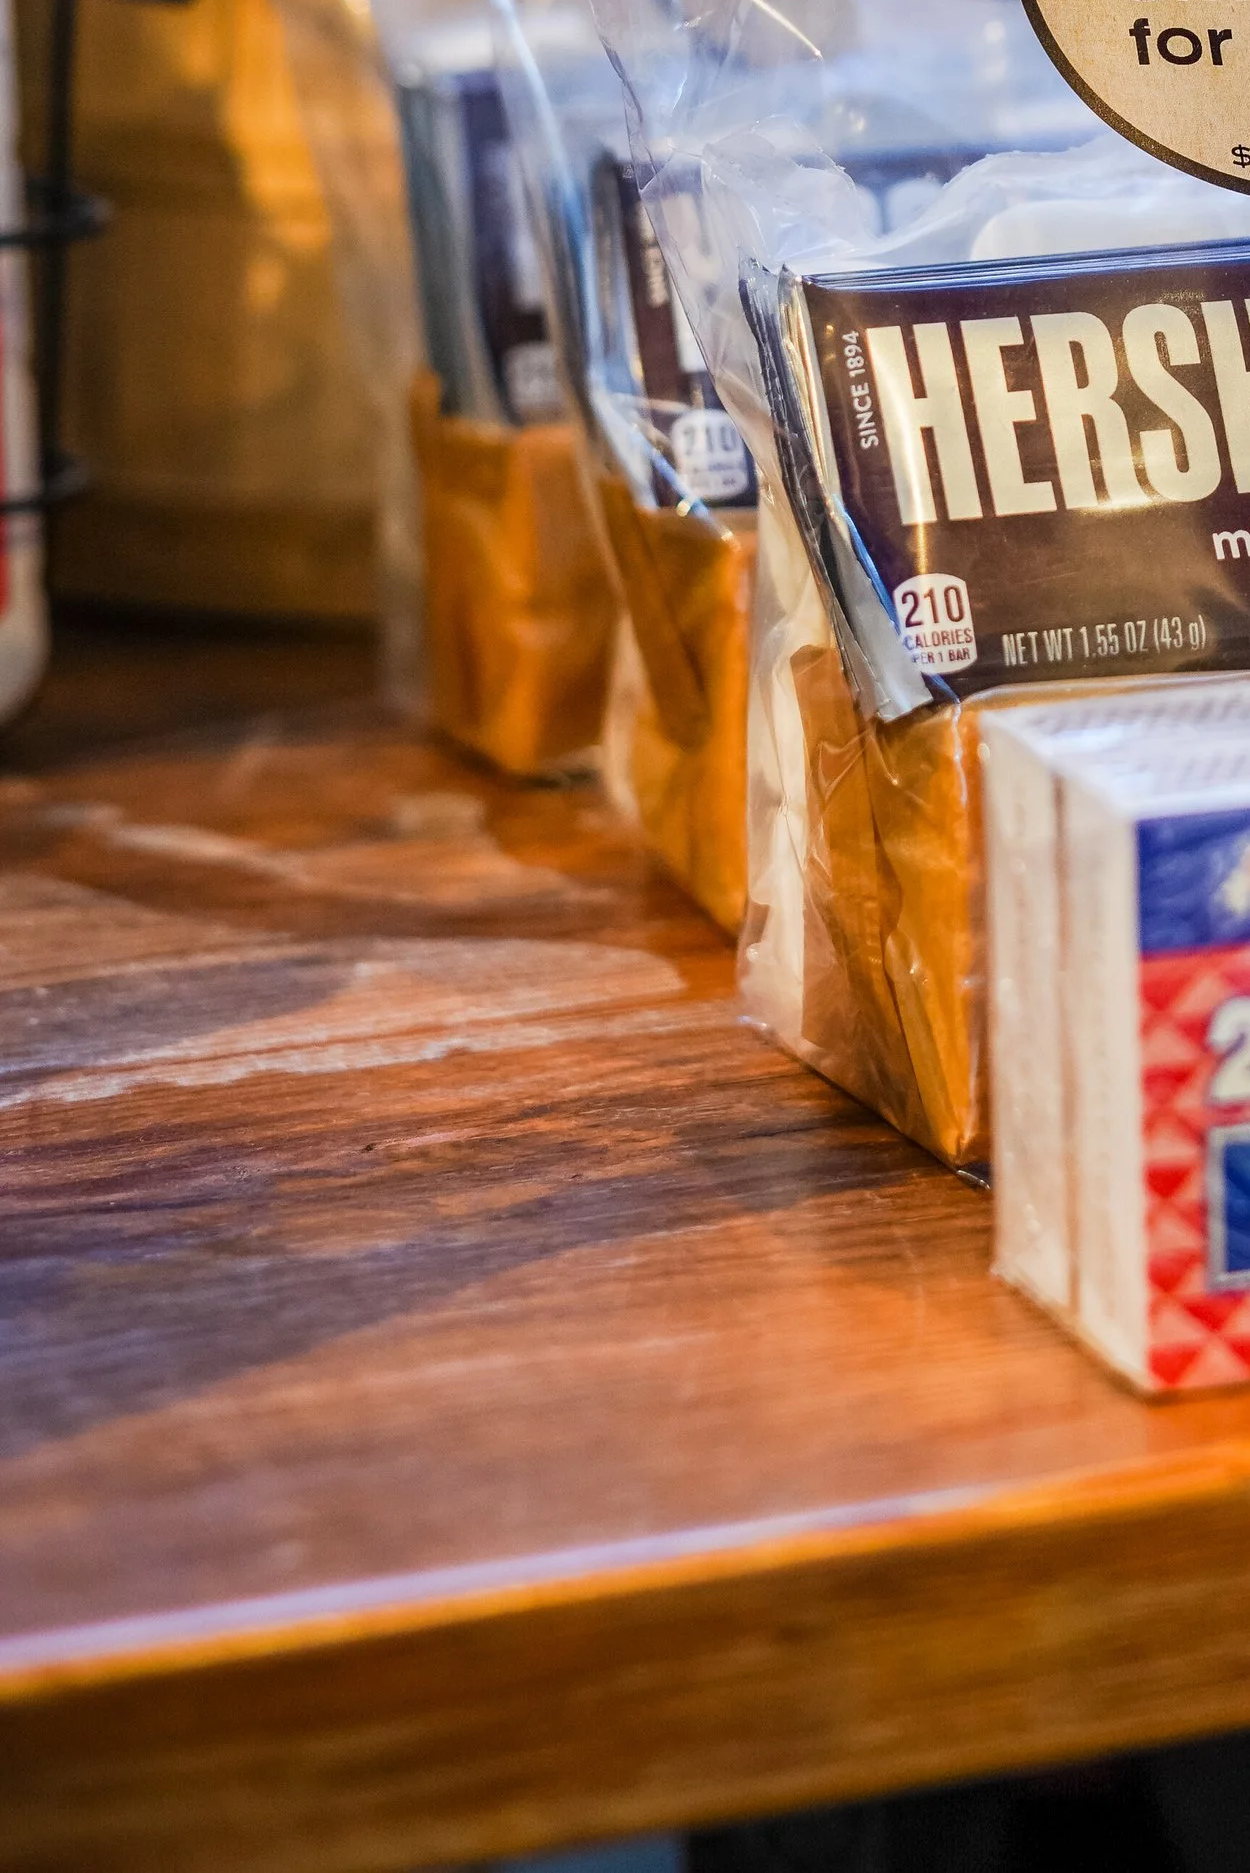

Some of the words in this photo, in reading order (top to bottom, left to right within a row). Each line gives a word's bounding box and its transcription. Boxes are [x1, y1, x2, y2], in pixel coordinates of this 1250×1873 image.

[1128, 17, 1233, 67] for
[840, 330, 866, 378] 1894
[851, 381, 879, 451] SINCE
[901, 585, 965, 628] 210
[903, 627, 974, 652] CALORIES
[938, 652, 945, 664] 1
[948, 647, 971, 663] BAR
[1003, 630, 1038, 667] NET
[1039, 627, 1075, 663] WT
[1079, 623, 1120, 658] 1.55
[1124, 620, 1149, 654] OZ
[1153, 616, 1185, 652] (43
[1188, 614, 1207, 651] g)
